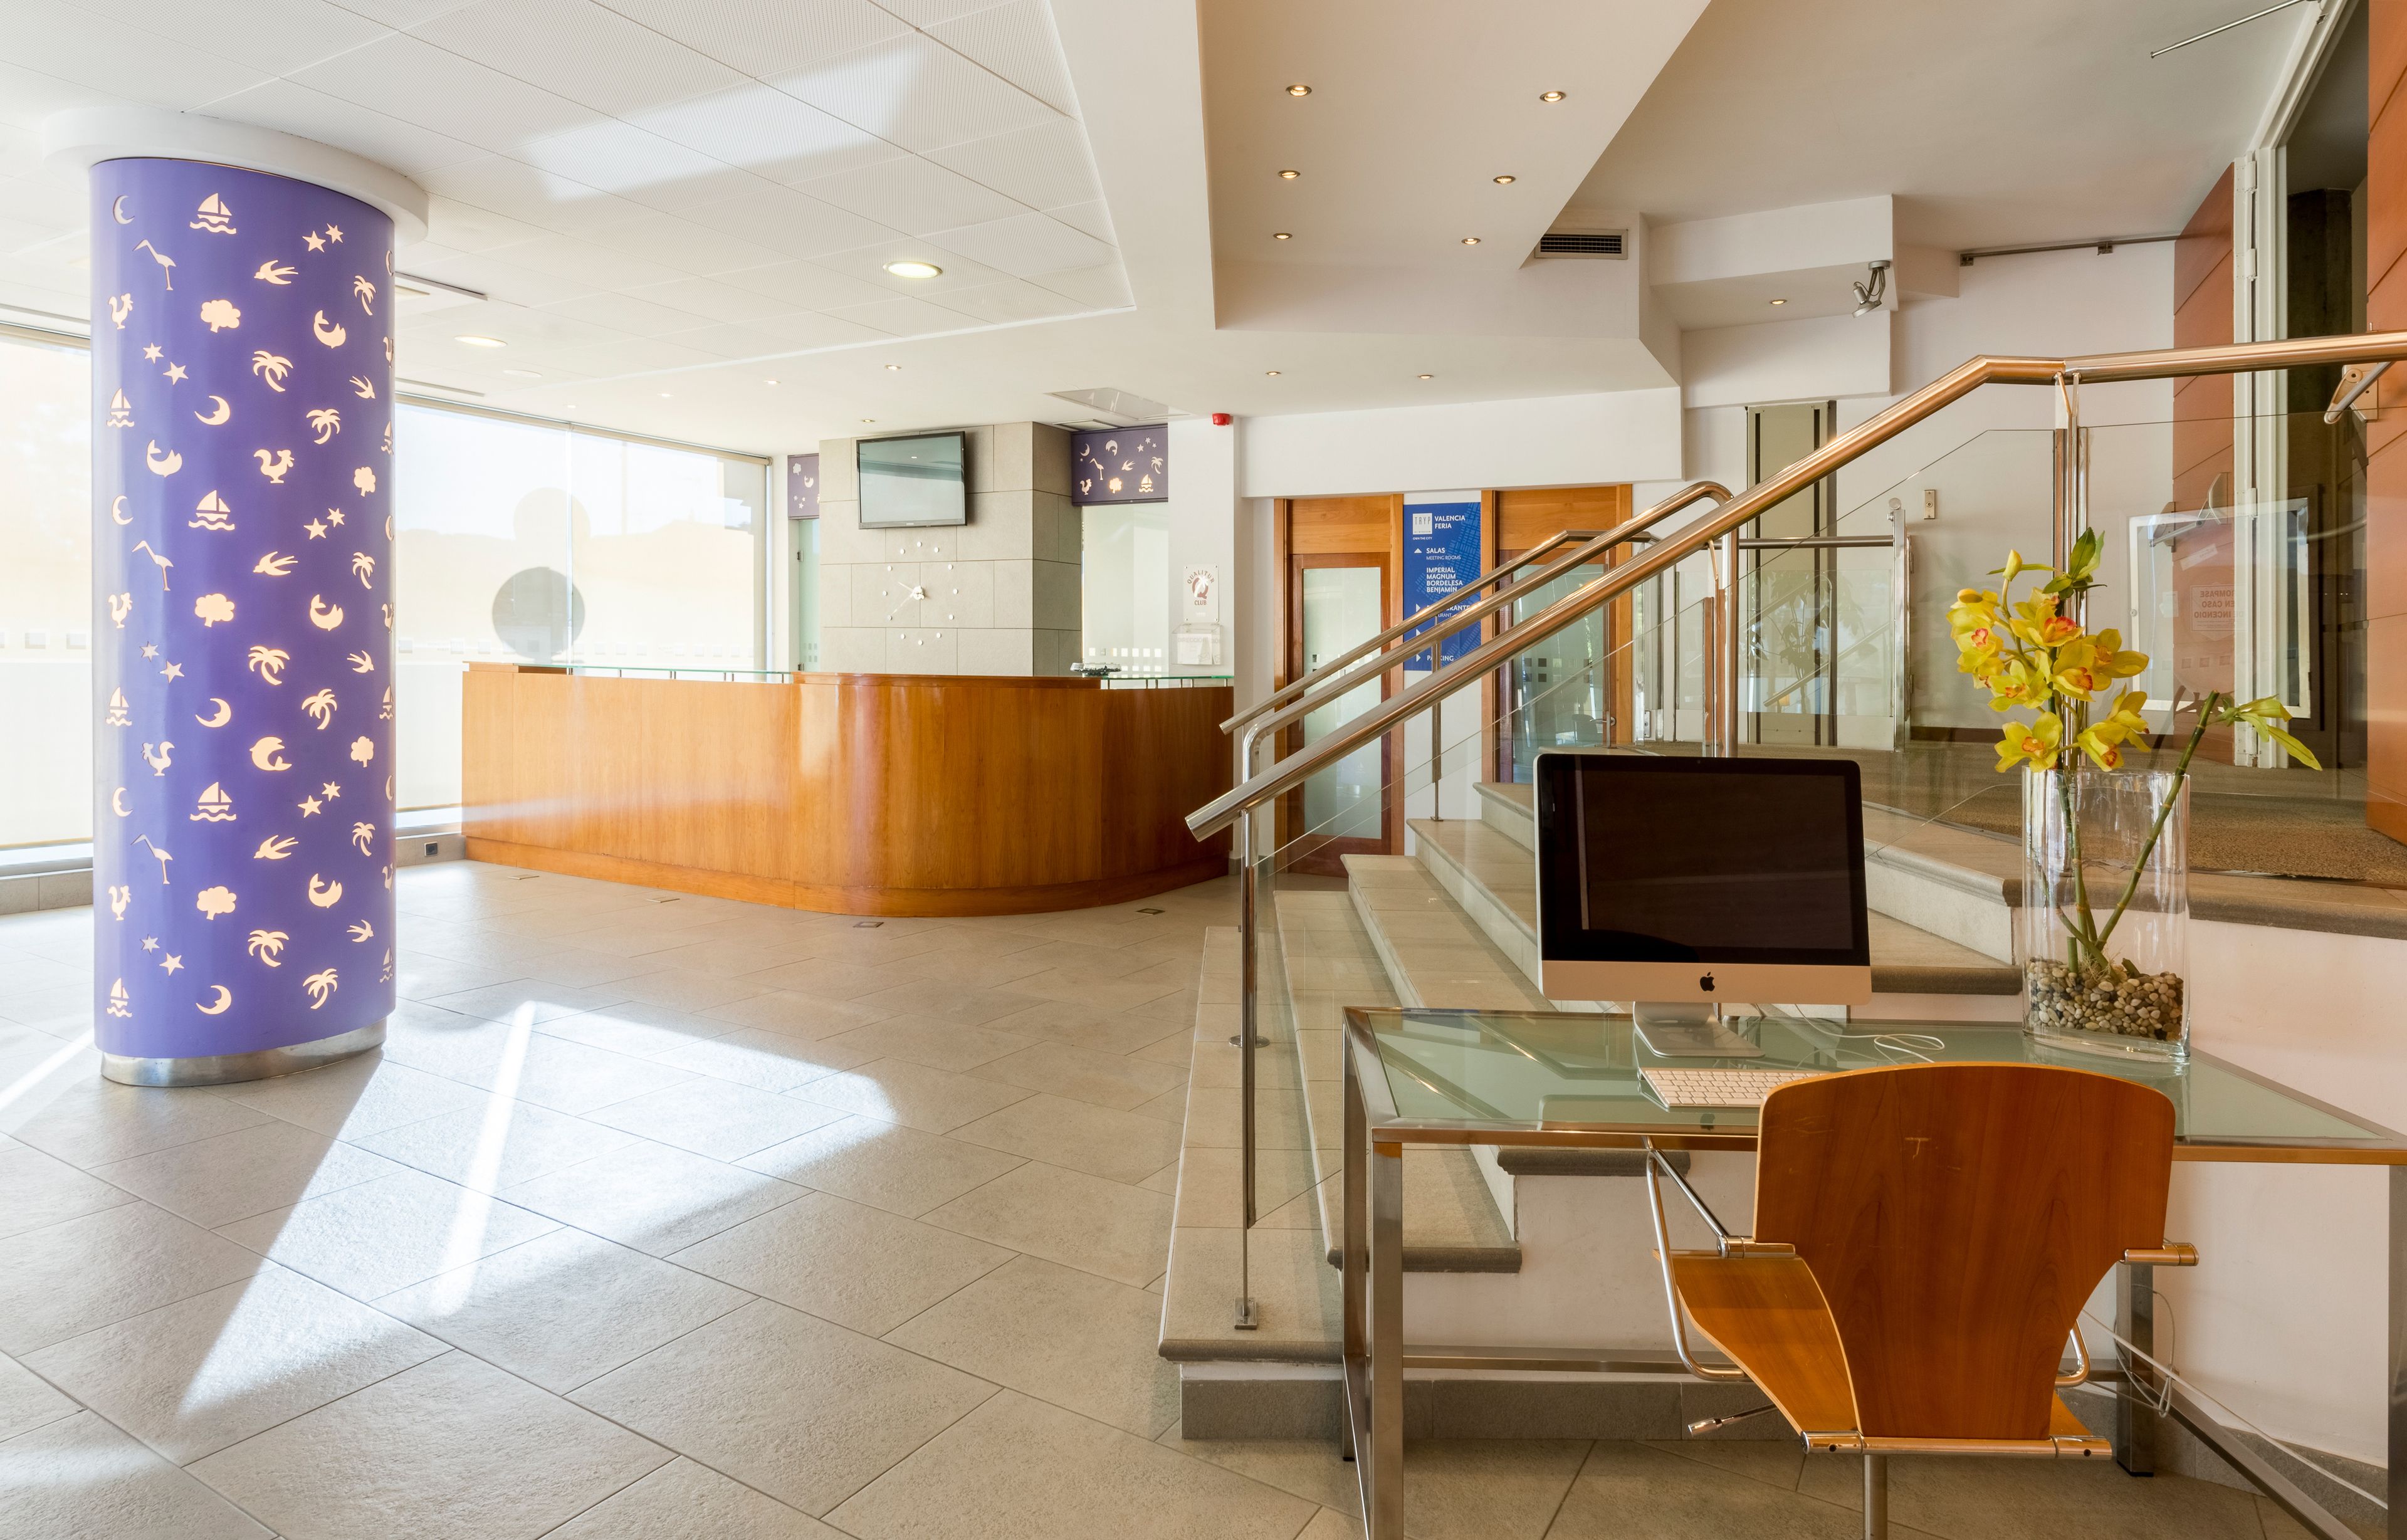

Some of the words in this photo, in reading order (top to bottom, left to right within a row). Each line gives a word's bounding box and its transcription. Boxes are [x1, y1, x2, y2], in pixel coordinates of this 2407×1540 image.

[1415, 516, 1431, 525] TRYP
[1187, 570, 1215, 584] QUALITUR
[1427, 585, 1457, 594] BENJAMÍN
